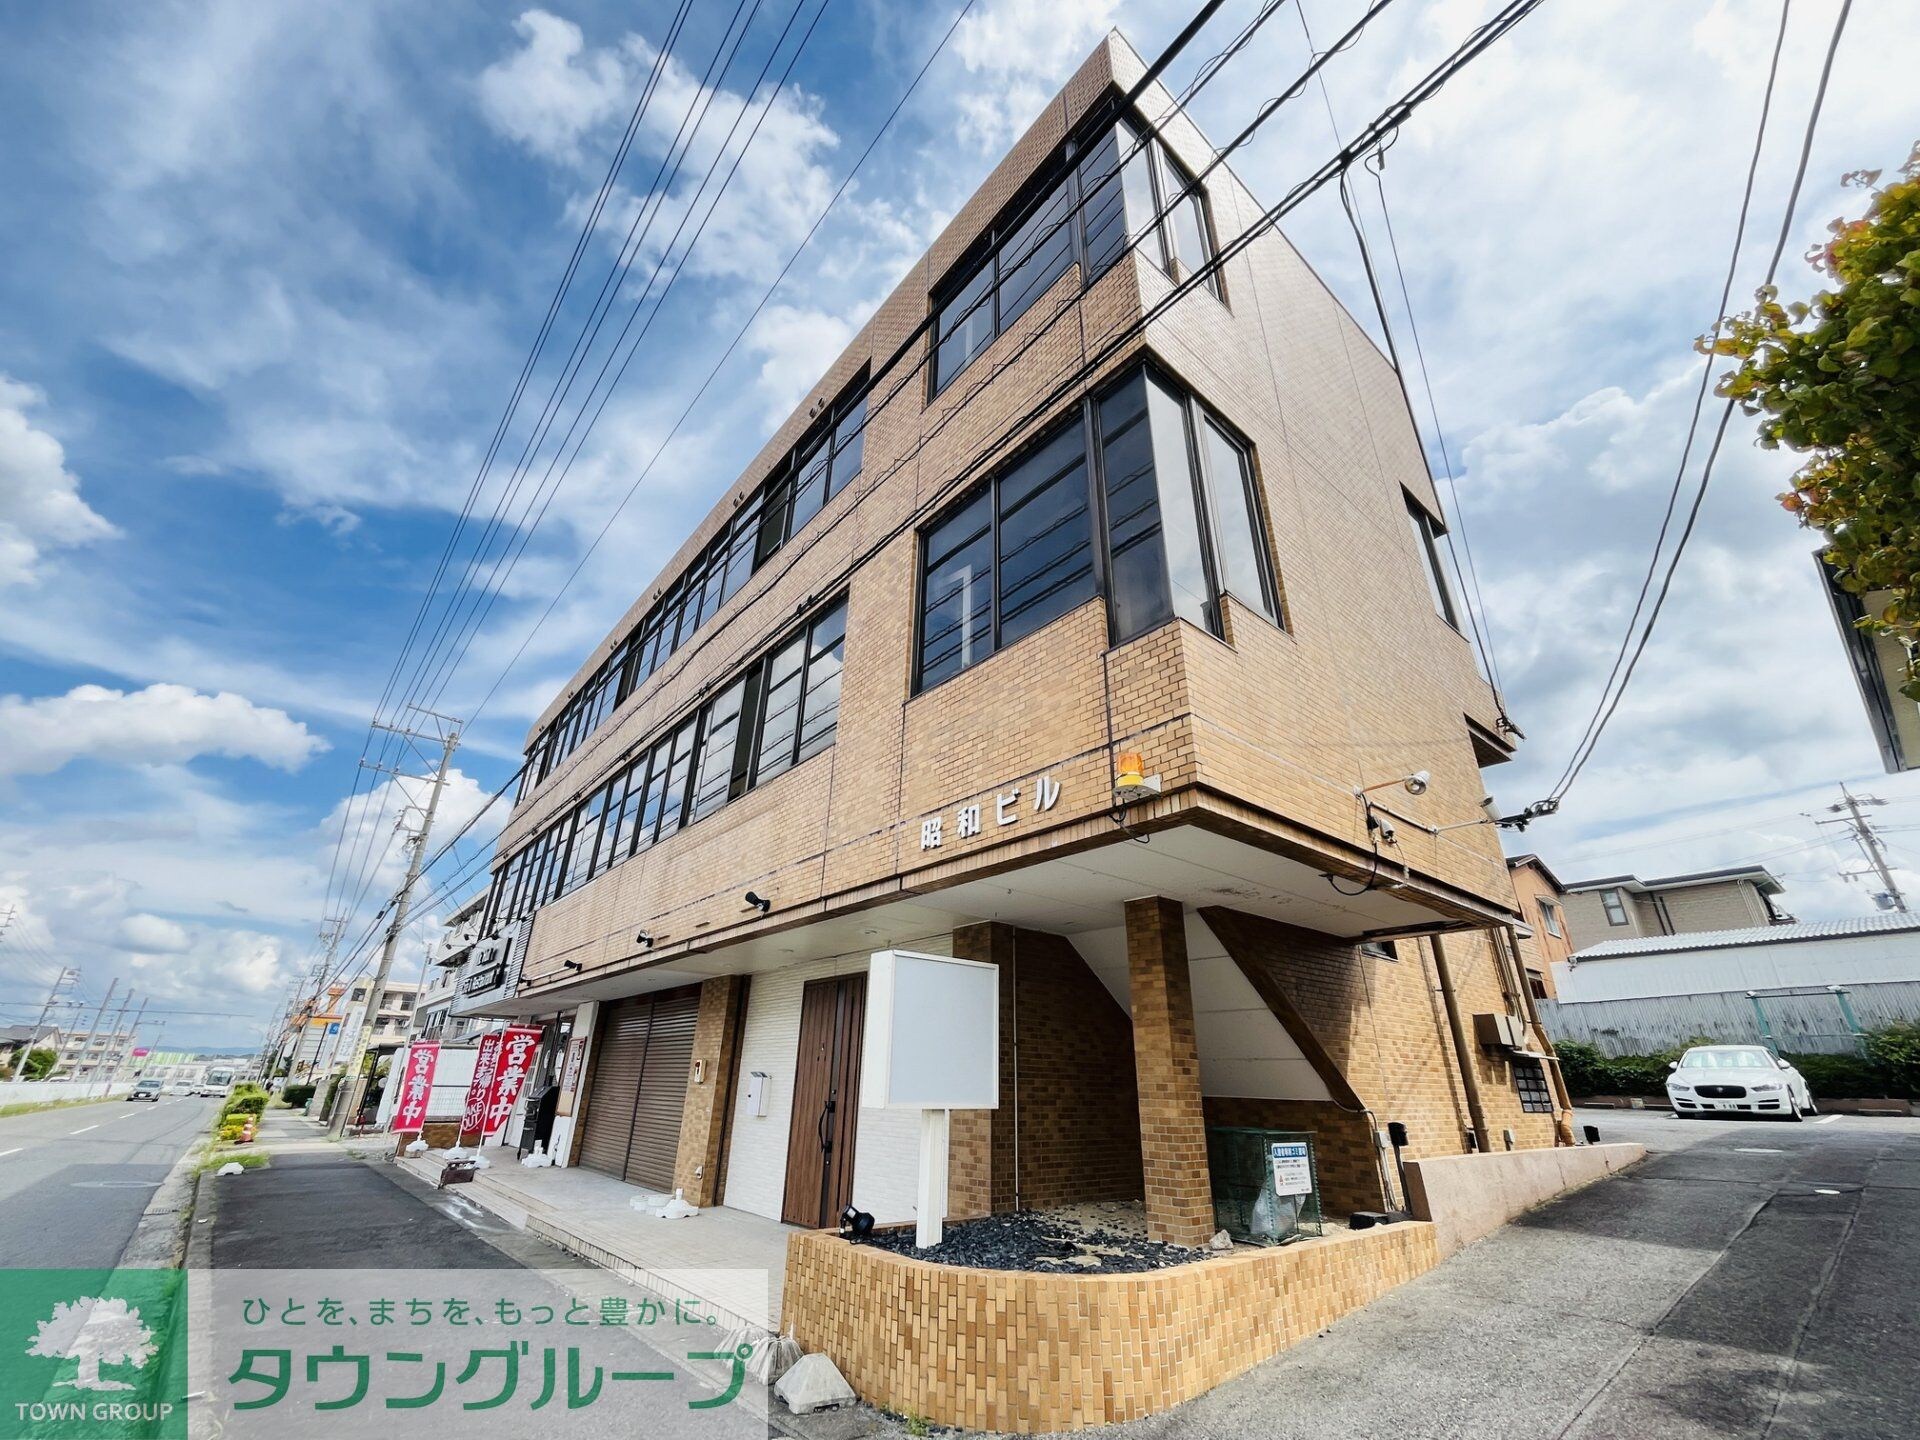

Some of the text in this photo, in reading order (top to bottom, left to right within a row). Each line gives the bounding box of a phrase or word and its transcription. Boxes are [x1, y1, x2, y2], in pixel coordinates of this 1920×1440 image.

[920, 775, 1061, 850] 昭和ビル
[403, 1049, 434, 1126] 営業中
[490, 1034, 535, 1129] 営業中
